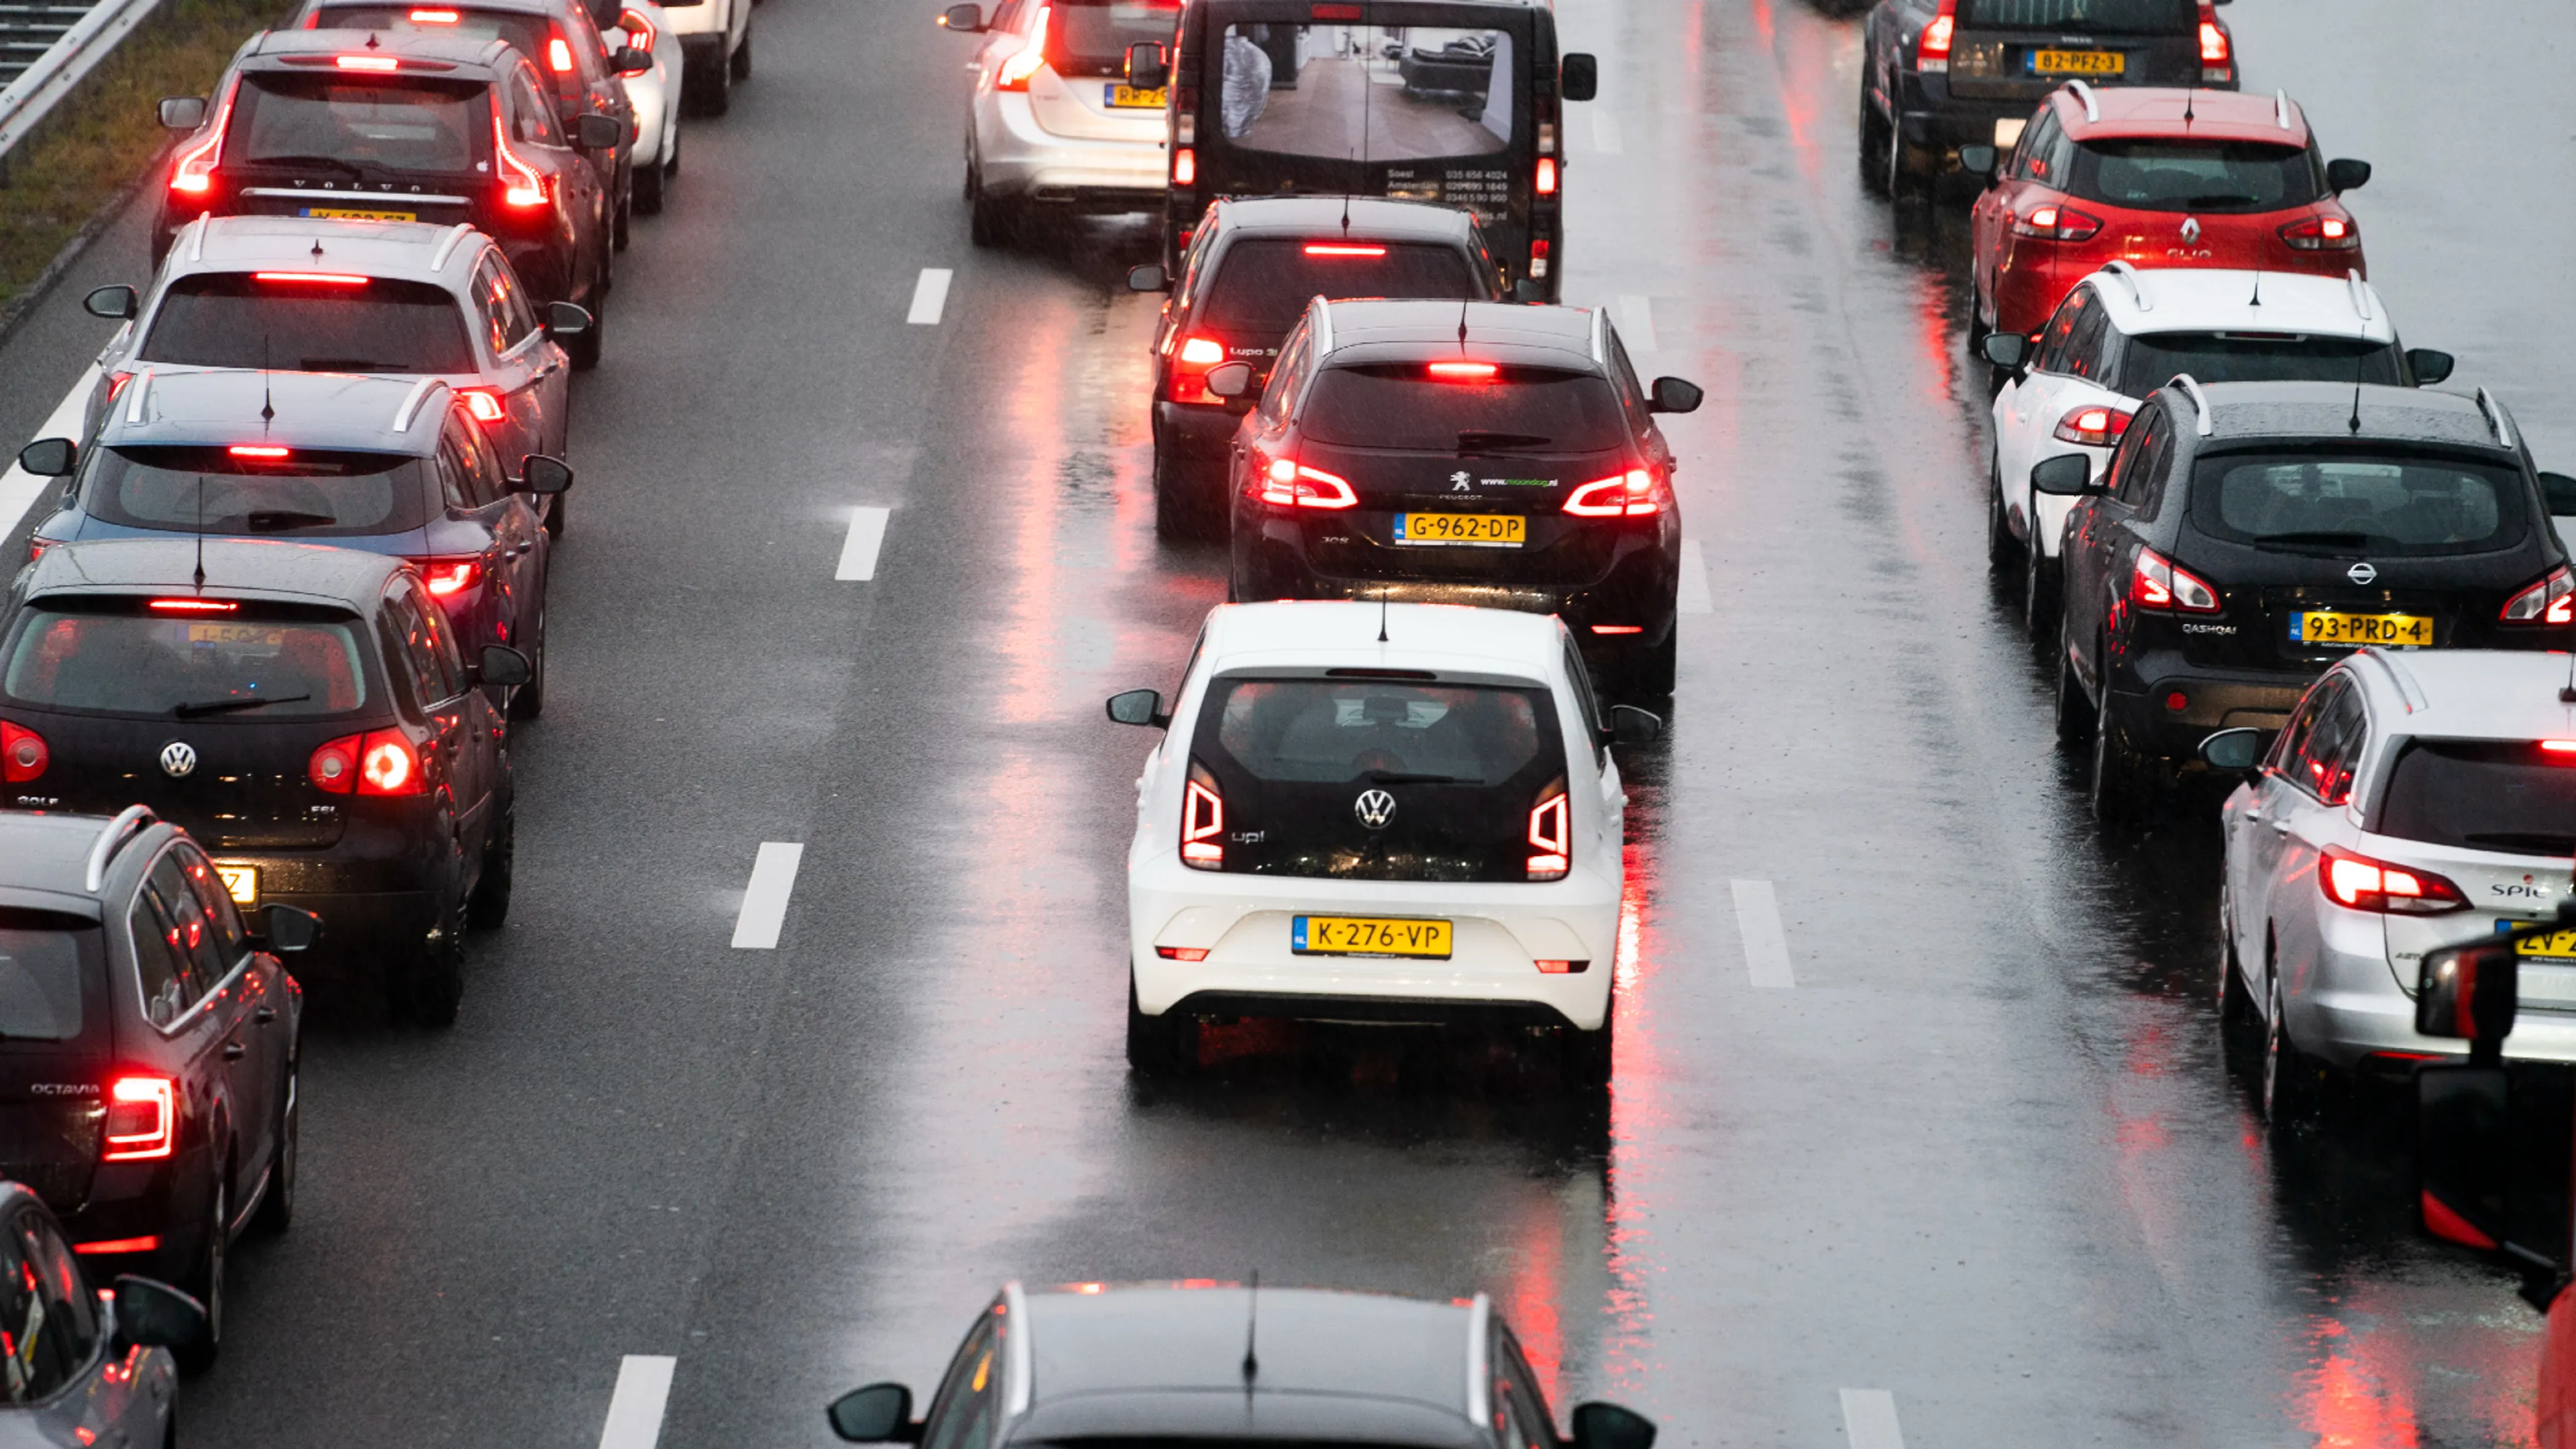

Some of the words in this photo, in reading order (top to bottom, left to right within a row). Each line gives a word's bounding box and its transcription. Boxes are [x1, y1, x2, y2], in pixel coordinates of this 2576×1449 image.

[2042, 52, 2116, 69] 82-PFZ-3
[294, 180, 421, 193] VOLVO
[1230, 347, 1263, 356] Lupo
[1413, 517, 1519, 537] G-962-DP
[2183, 623, 2237, 635] QASHQAI
[2310, 616, 2422, 641] 93-PRD-4
[17, 796, 58, 805] GOLF
[1232, 830, 1265, 844] up!
[1318, 923, 1440, 947] K-276-VP
[31, 1083, 100, 1095] OCTAVIA
